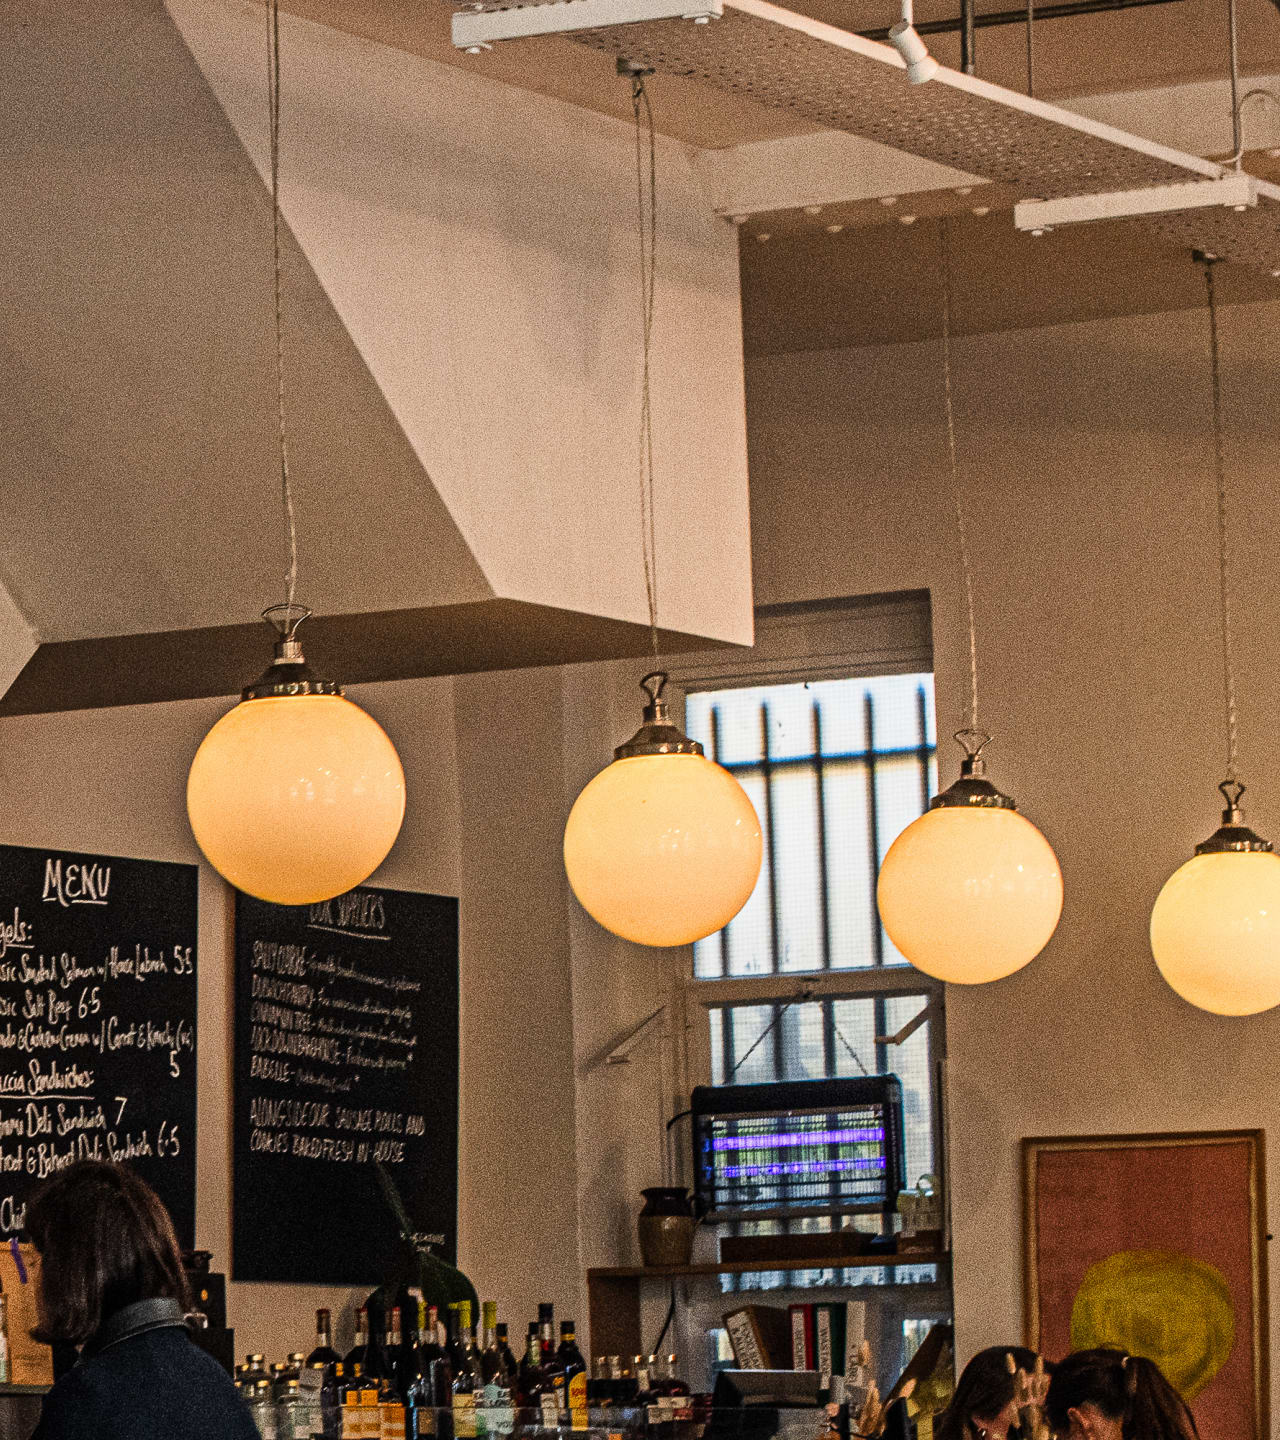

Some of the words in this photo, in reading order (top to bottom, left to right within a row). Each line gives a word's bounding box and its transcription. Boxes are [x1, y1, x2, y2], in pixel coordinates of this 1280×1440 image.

[42, 858, 111, 905] MENU
[19, 953, 58, 984] Smoked
[60, 952, 96, 989] Salmon
[109, 947, 134, 979] House
[22, 989, 44, 1019] Salt
[48, 989, 72, 1025] Beef
[107, 1015, 137, 1051] Carrot
[28, 1058, 94, 1096] Sandwiches:
[170, 1050, 180, 1078] 5
[26, 1102, 52, 1138] Deli
[57, 1103, 107, 1136] Sandwich
[114, 1096, 128, 1126] 7
[374, 1109, 403, 1133] ROLLS
[405, 1115, 426, 1136] AND
[79, 1133, 103, 1162] Deli
[107, 1131, 153, 1162] Sandwich
[292, 1134, 322, 1158] BAKED
[322, 1138, 354, 1162] FRESH
